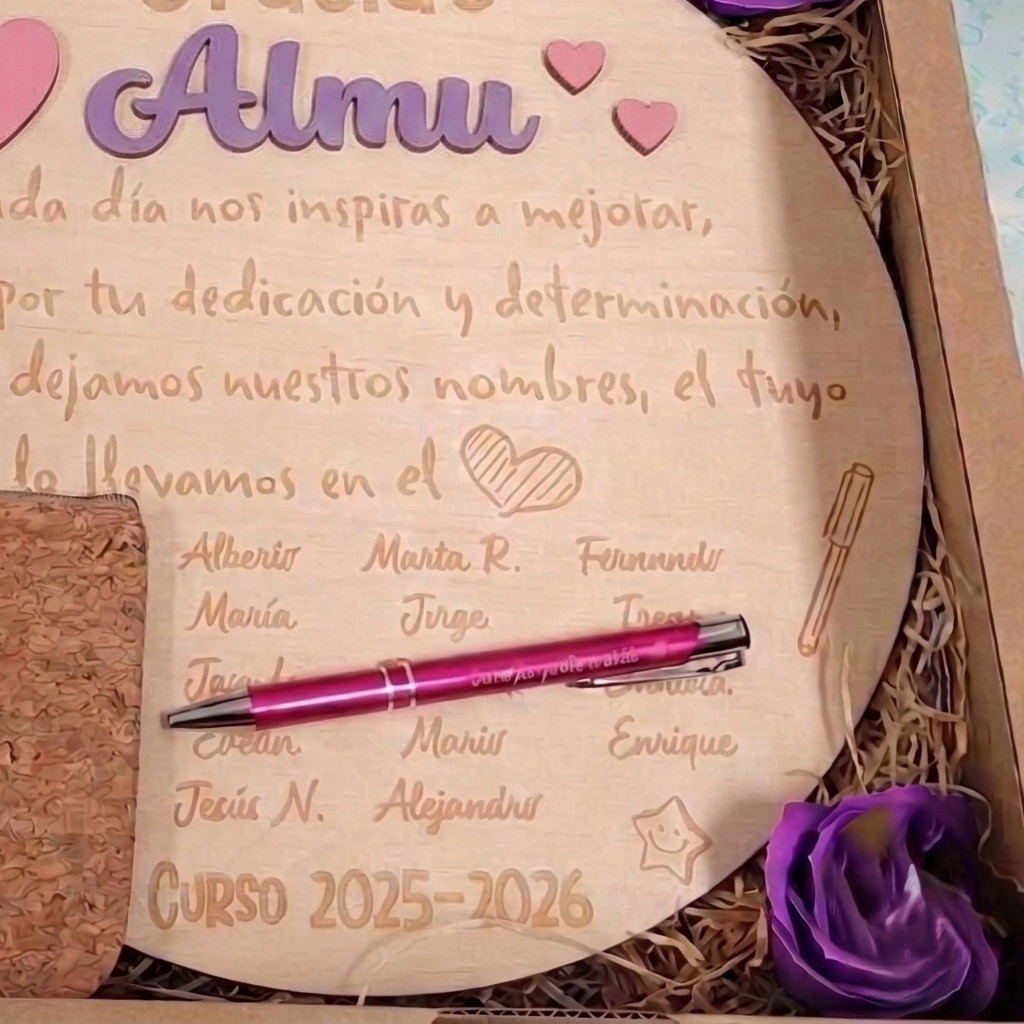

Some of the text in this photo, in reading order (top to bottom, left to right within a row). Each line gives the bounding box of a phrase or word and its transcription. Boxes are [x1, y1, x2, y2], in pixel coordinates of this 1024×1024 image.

[84, 23, 542, 158] Almu
[91, 165, 168, 224] día
[191, 192, 264, 224] nos
[288, 188, 450, 244] inspiras
[475, 201, 501, 227] a
[521, 188, 713, 248] mejorar,
[84, 267, 147, 317] tu
[172, 257, 421, 318] dedicación
[444, 285, 474, 338] y
[495, 260, 841, 331] determinación,
[9, 338, 204, 422] dejamos
[223, 352, 410, 405] nuestros
[434, 343, 650, 413] nombres,
[674, 348, 717, 408] el
[736, 348, 847, 420] tuyo
[85, 434, 296, 500] llevamos
[321, 468, 375, 499] en
[397, 437, 442, 500] el
[361, 532, 520, 574] Marta R.
[185, 591, 298, 633] María
[608, 715, 739, 771] Enrique
[173, 778, 325, 828] Jesús N.
[309, 867, 594, 932] 2025-2026
